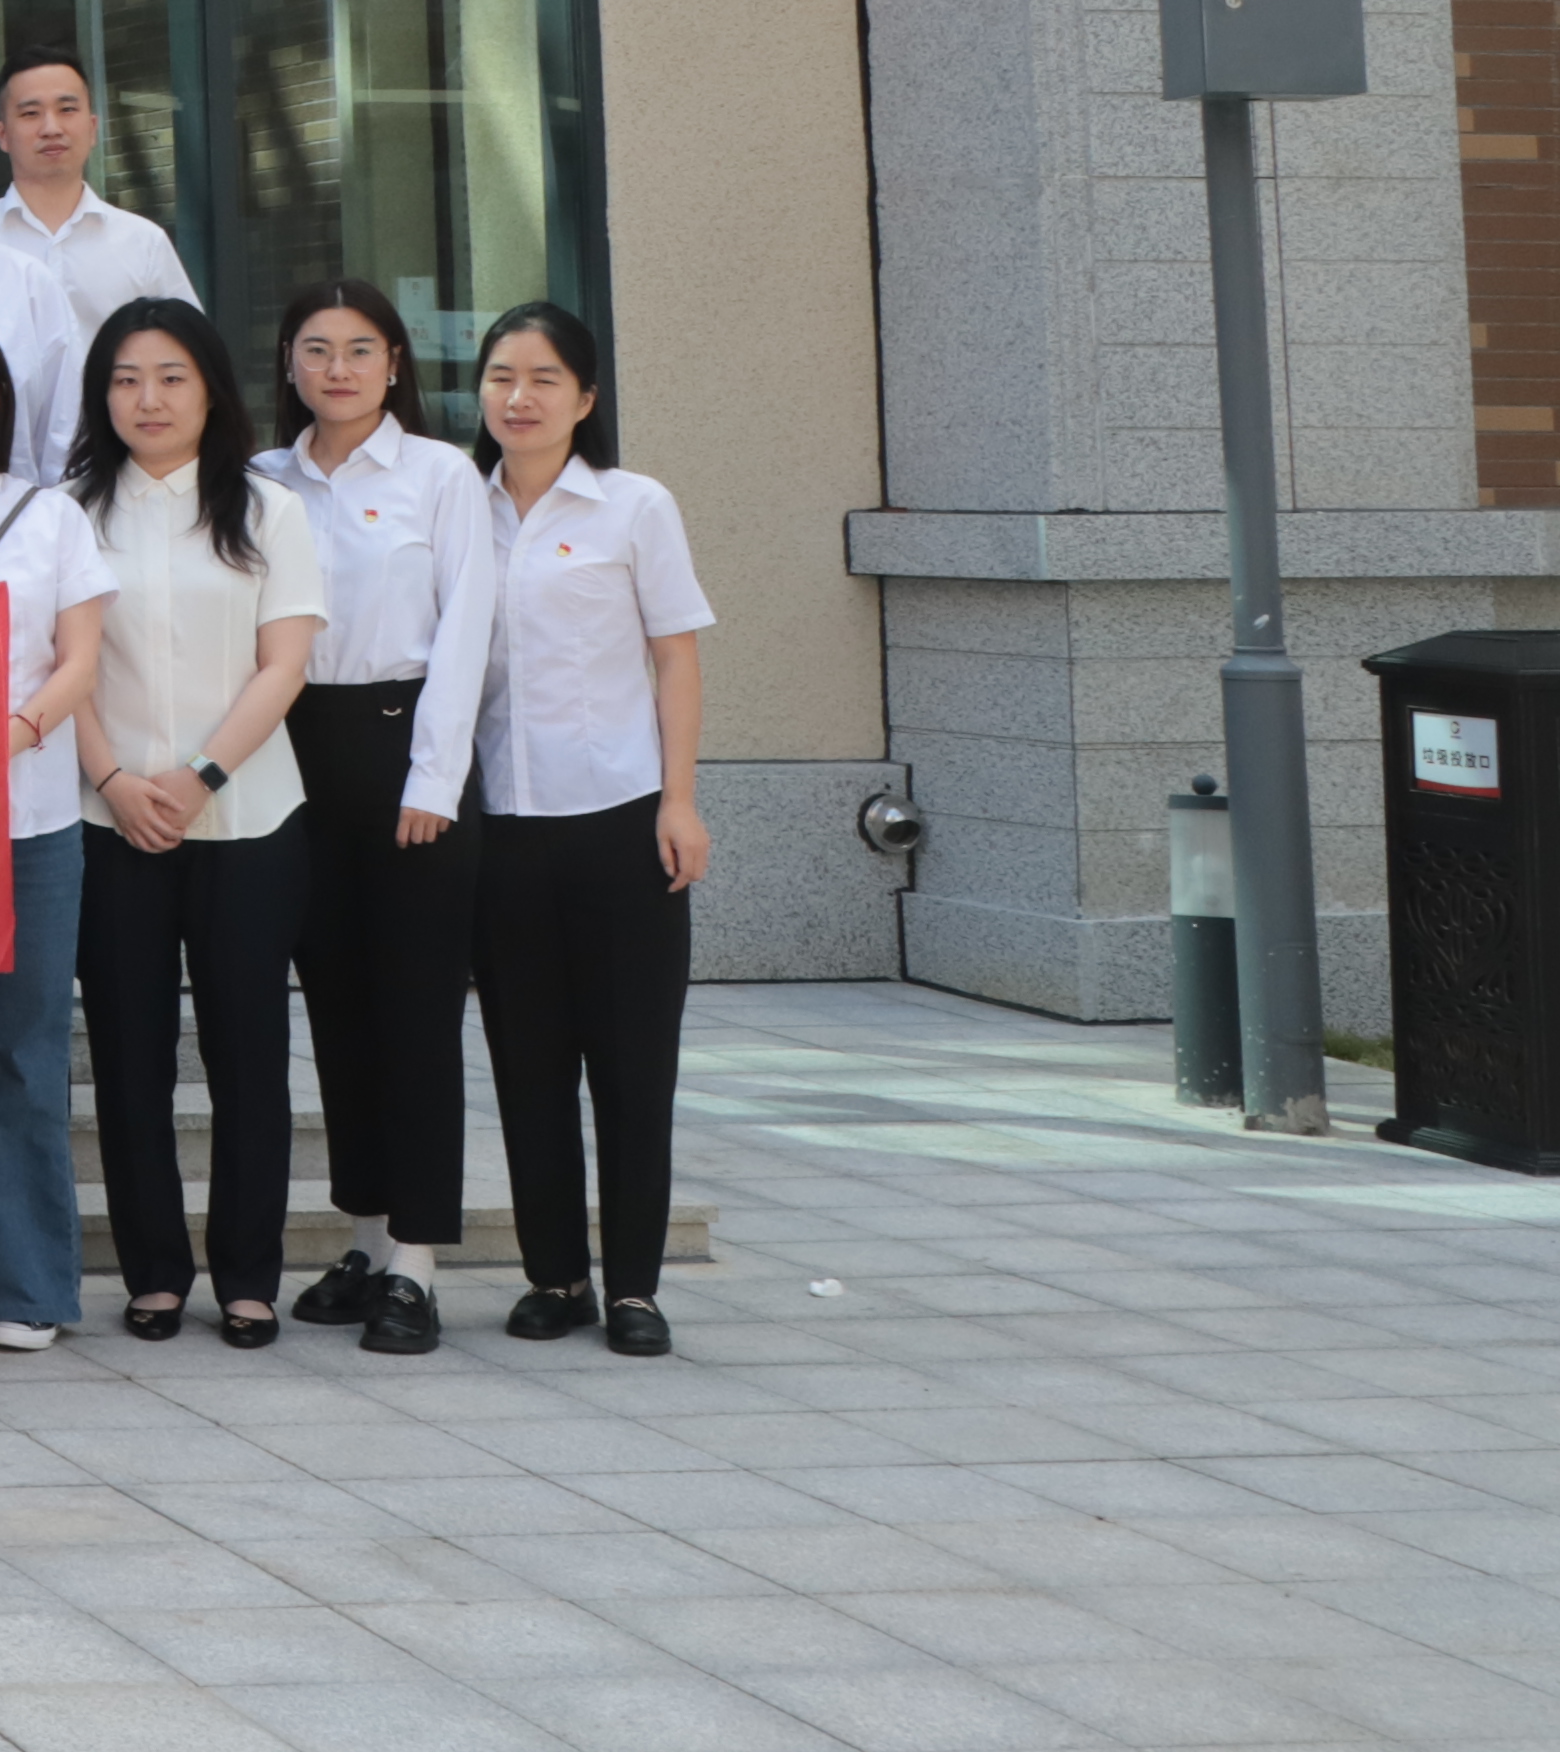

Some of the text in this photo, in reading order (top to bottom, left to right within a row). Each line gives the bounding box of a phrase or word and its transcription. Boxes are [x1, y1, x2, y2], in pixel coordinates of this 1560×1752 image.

[1422, 747, 1490, 769] 垃圾投放口
